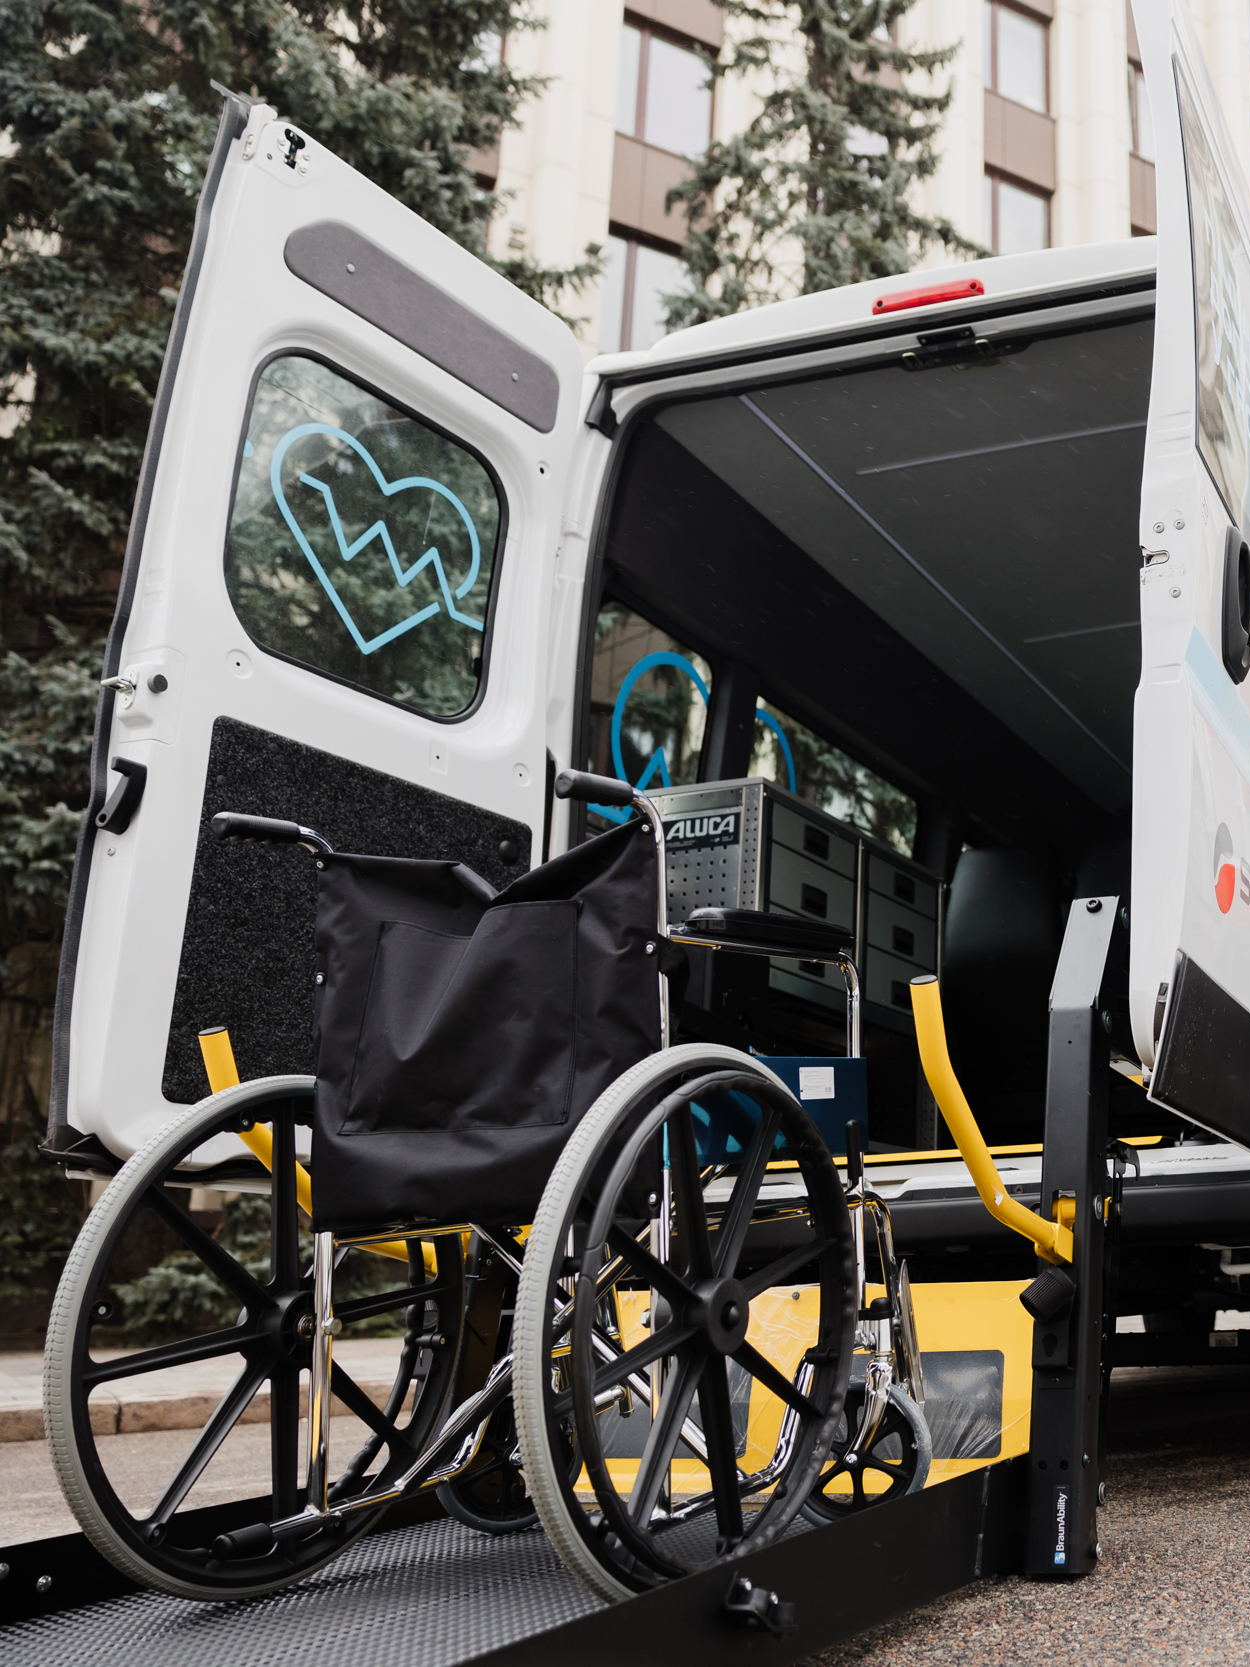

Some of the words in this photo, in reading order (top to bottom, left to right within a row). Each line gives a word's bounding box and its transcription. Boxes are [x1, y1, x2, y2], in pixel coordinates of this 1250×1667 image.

[1211, 317, 1222, 366] У
[666, 815, 735, 840] ALUCA
[1056, 1491, 1068, 1551] BraunAbility
